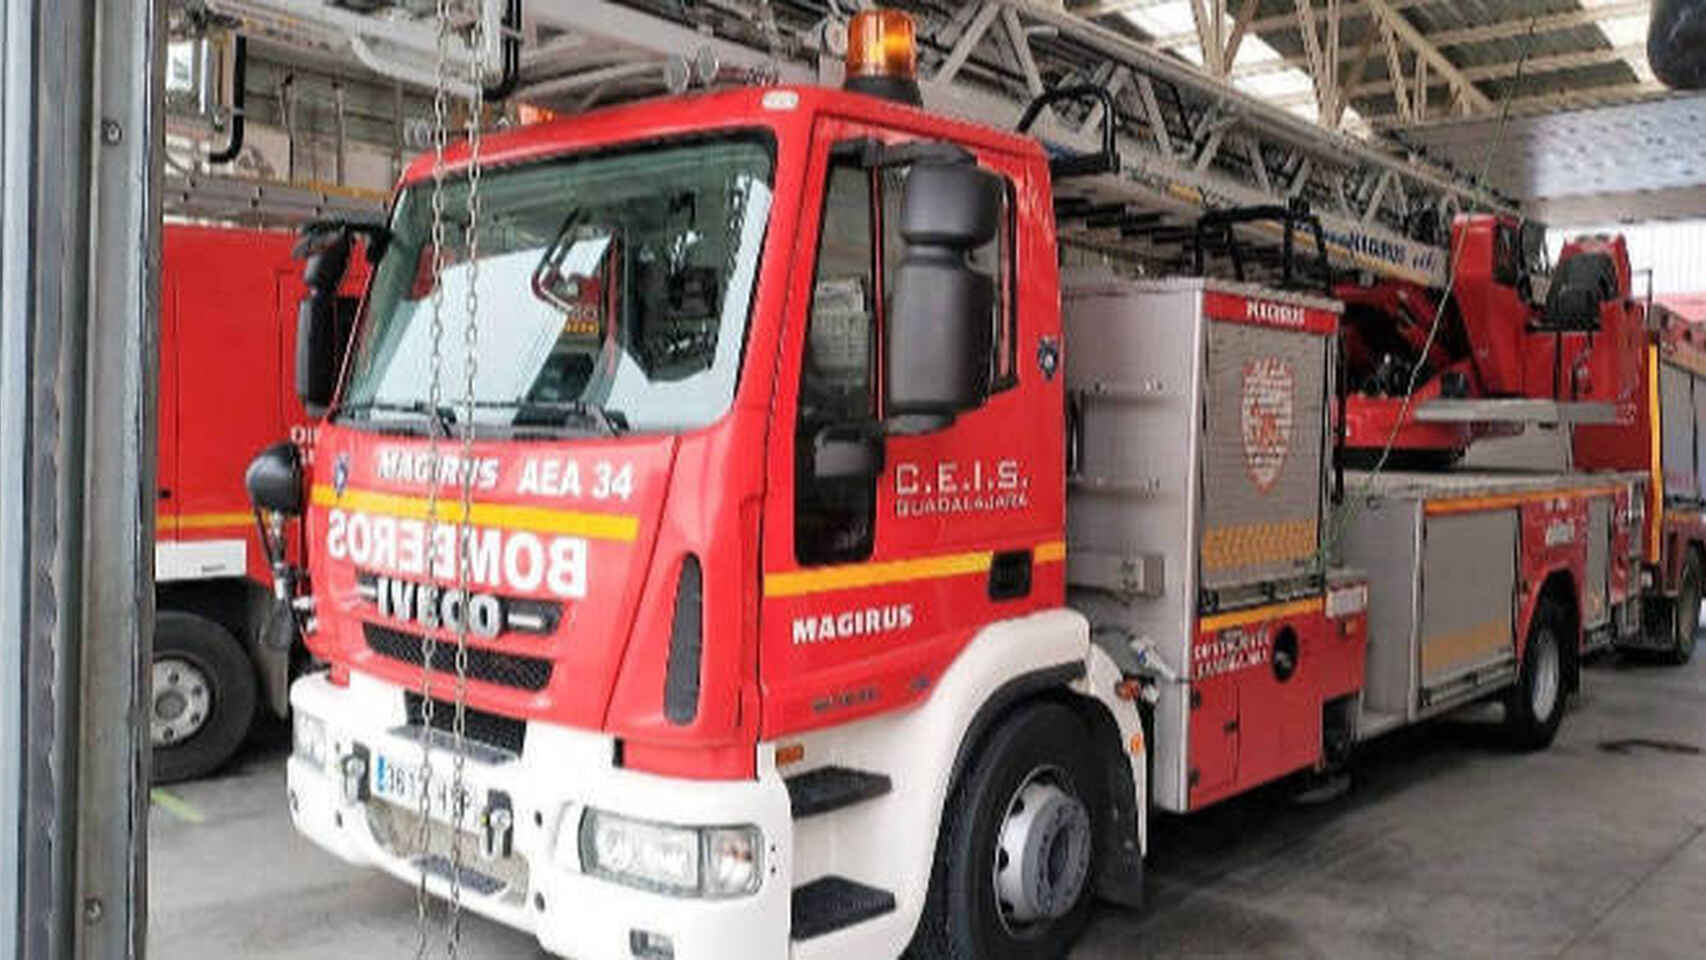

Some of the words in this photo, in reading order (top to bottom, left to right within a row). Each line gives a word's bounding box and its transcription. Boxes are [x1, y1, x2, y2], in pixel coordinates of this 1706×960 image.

[516, 456, 582, 498] AEA
[592, 461, 635, 500] 34
[896, 459, 1029, 496] C.E.I.S.
[376, 576, 502, 640] IVECO
[792, 604, 914, 645] MAGIRUS
